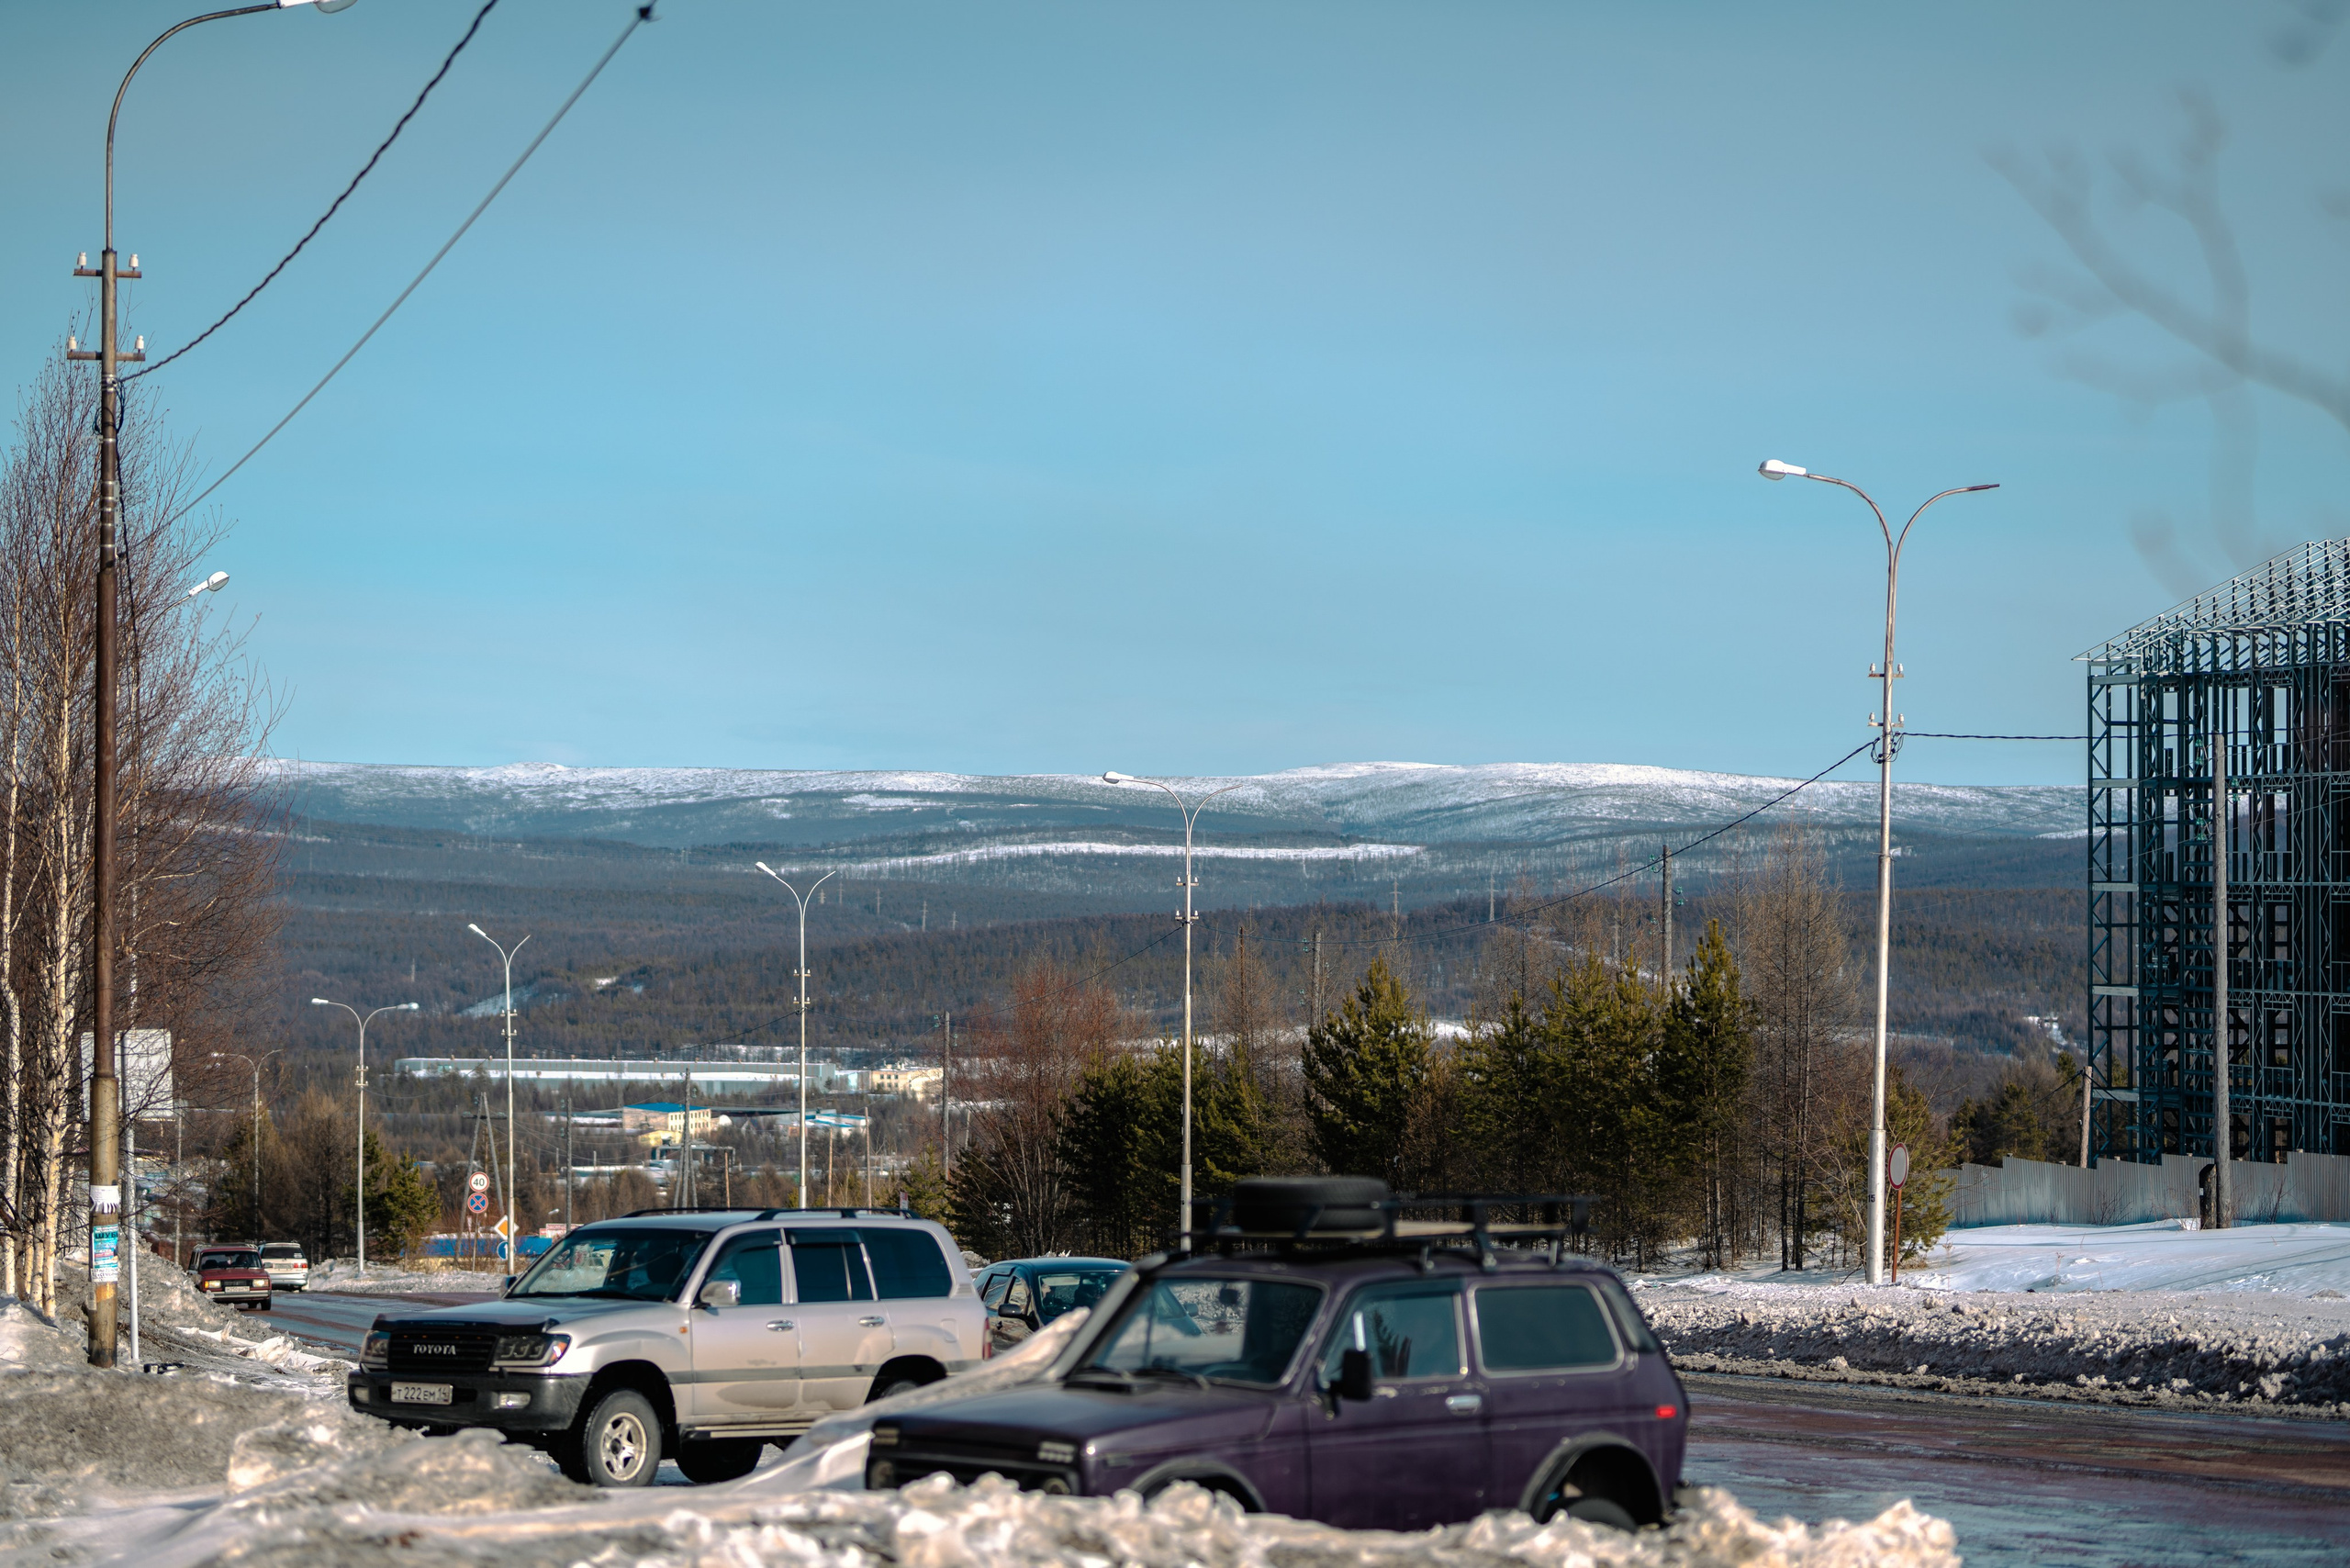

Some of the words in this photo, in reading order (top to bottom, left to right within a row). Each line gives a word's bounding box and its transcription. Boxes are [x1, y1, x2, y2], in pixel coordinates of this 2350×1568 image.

[473, 1178, 485, 1187] 40
[1868, 1194, 1875, 1203] 15
[413, 1344, 456, 1355] TOYOTA
